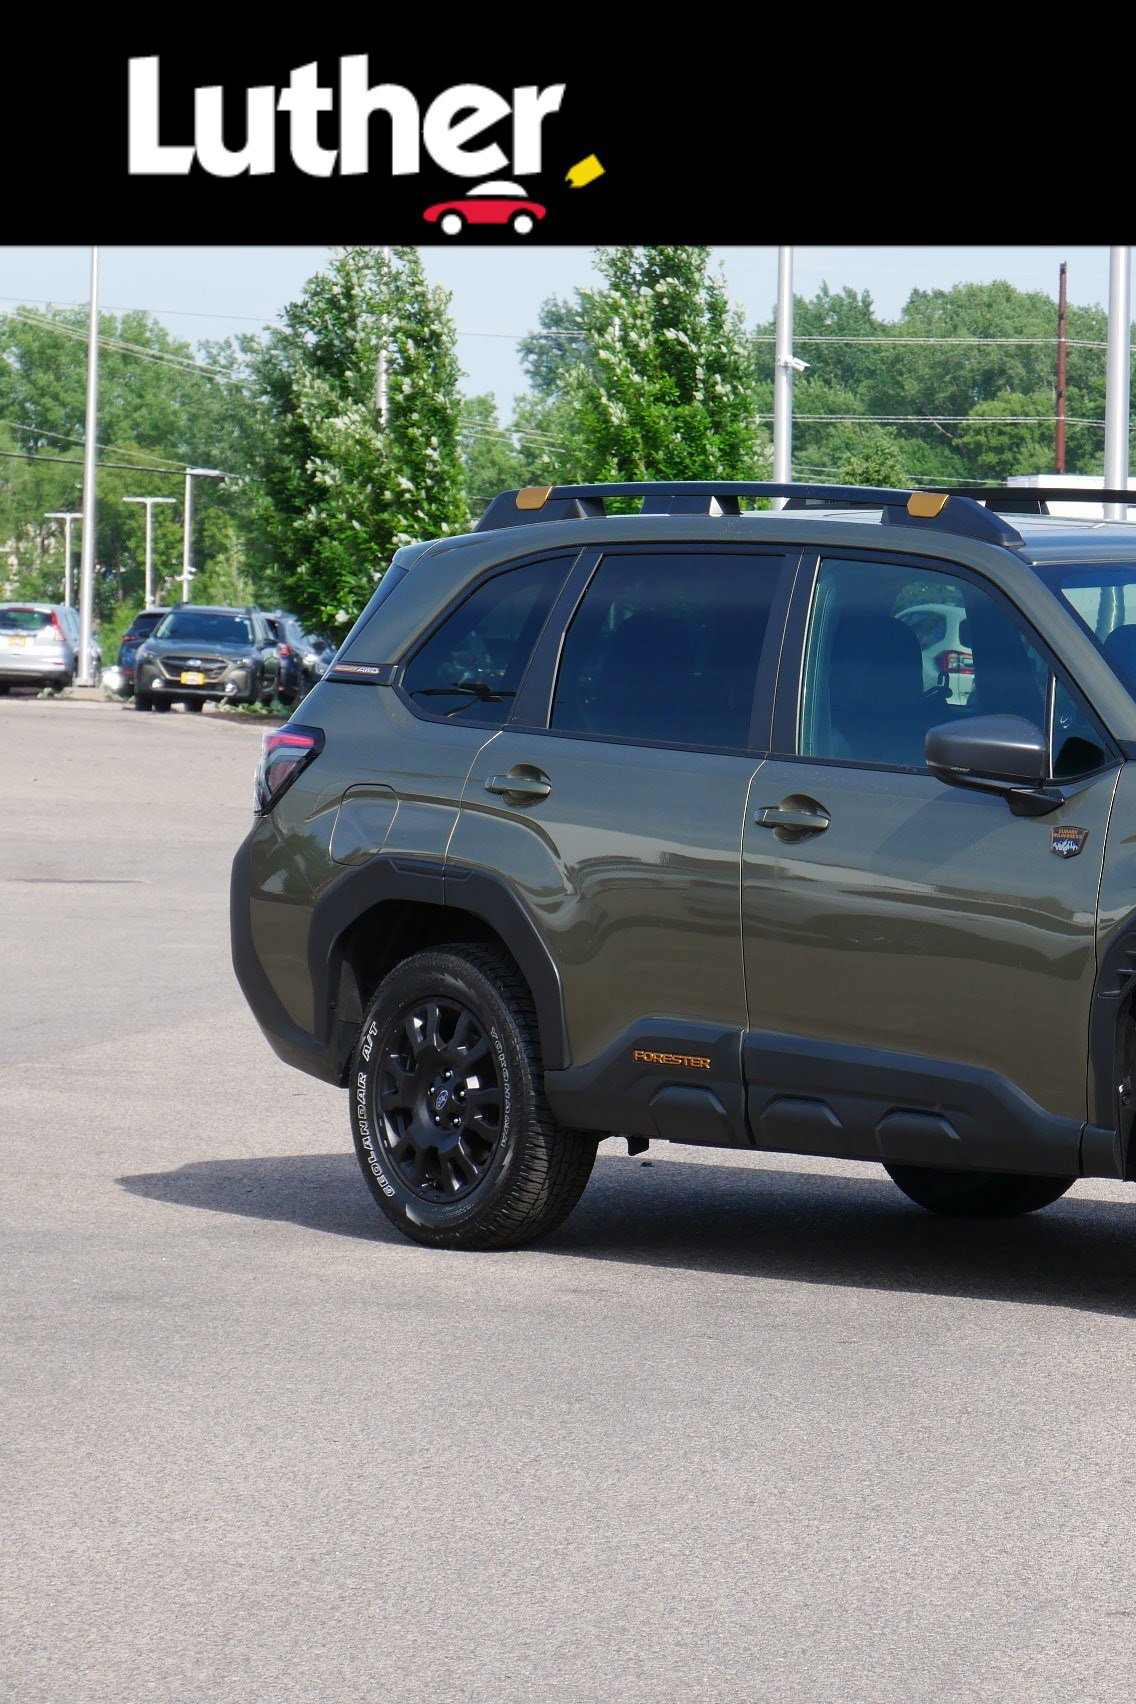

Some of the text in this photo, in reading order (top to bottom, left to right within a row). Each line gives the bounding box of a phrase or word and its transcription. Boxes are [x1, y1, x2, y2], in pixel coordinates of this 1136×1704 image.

[361, 1020, 379, 1062] A/T
[634, 1050, 711, 1069] FORESTER
[356, 1072, 396, 1197] GEOLANDAR
